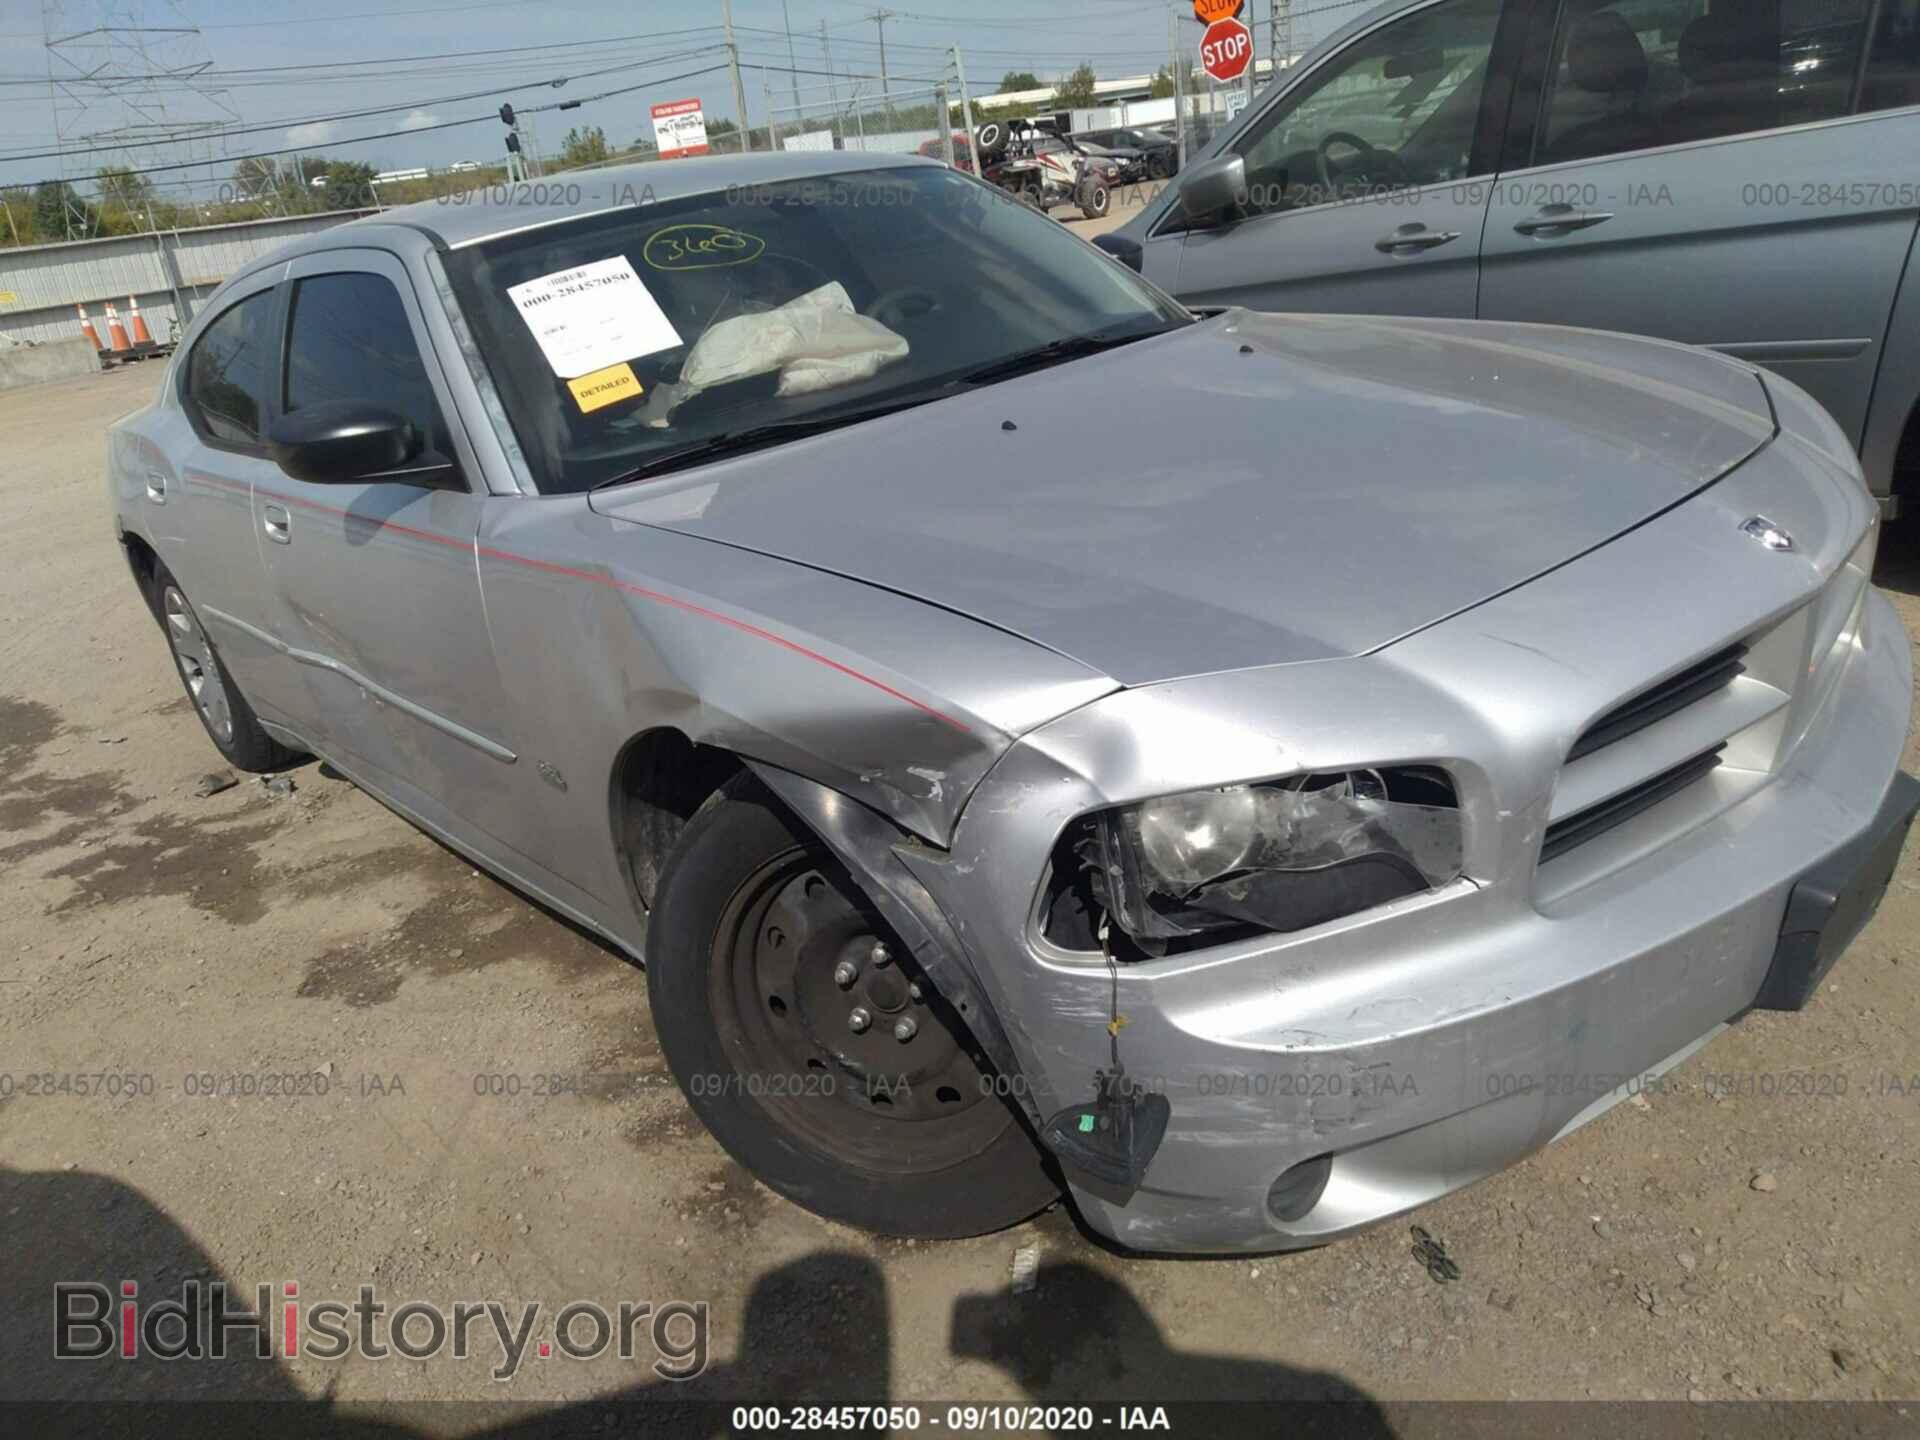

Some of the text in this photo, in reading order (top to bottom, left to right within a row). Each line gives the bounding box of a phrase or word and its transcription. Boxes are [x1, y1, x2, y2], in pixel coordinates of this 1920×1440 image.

[1203, 33, 1248, 67] STOP
[523, 272, 631, 309] 000-28457050
[580, 376, 631, 399] DETAILED
